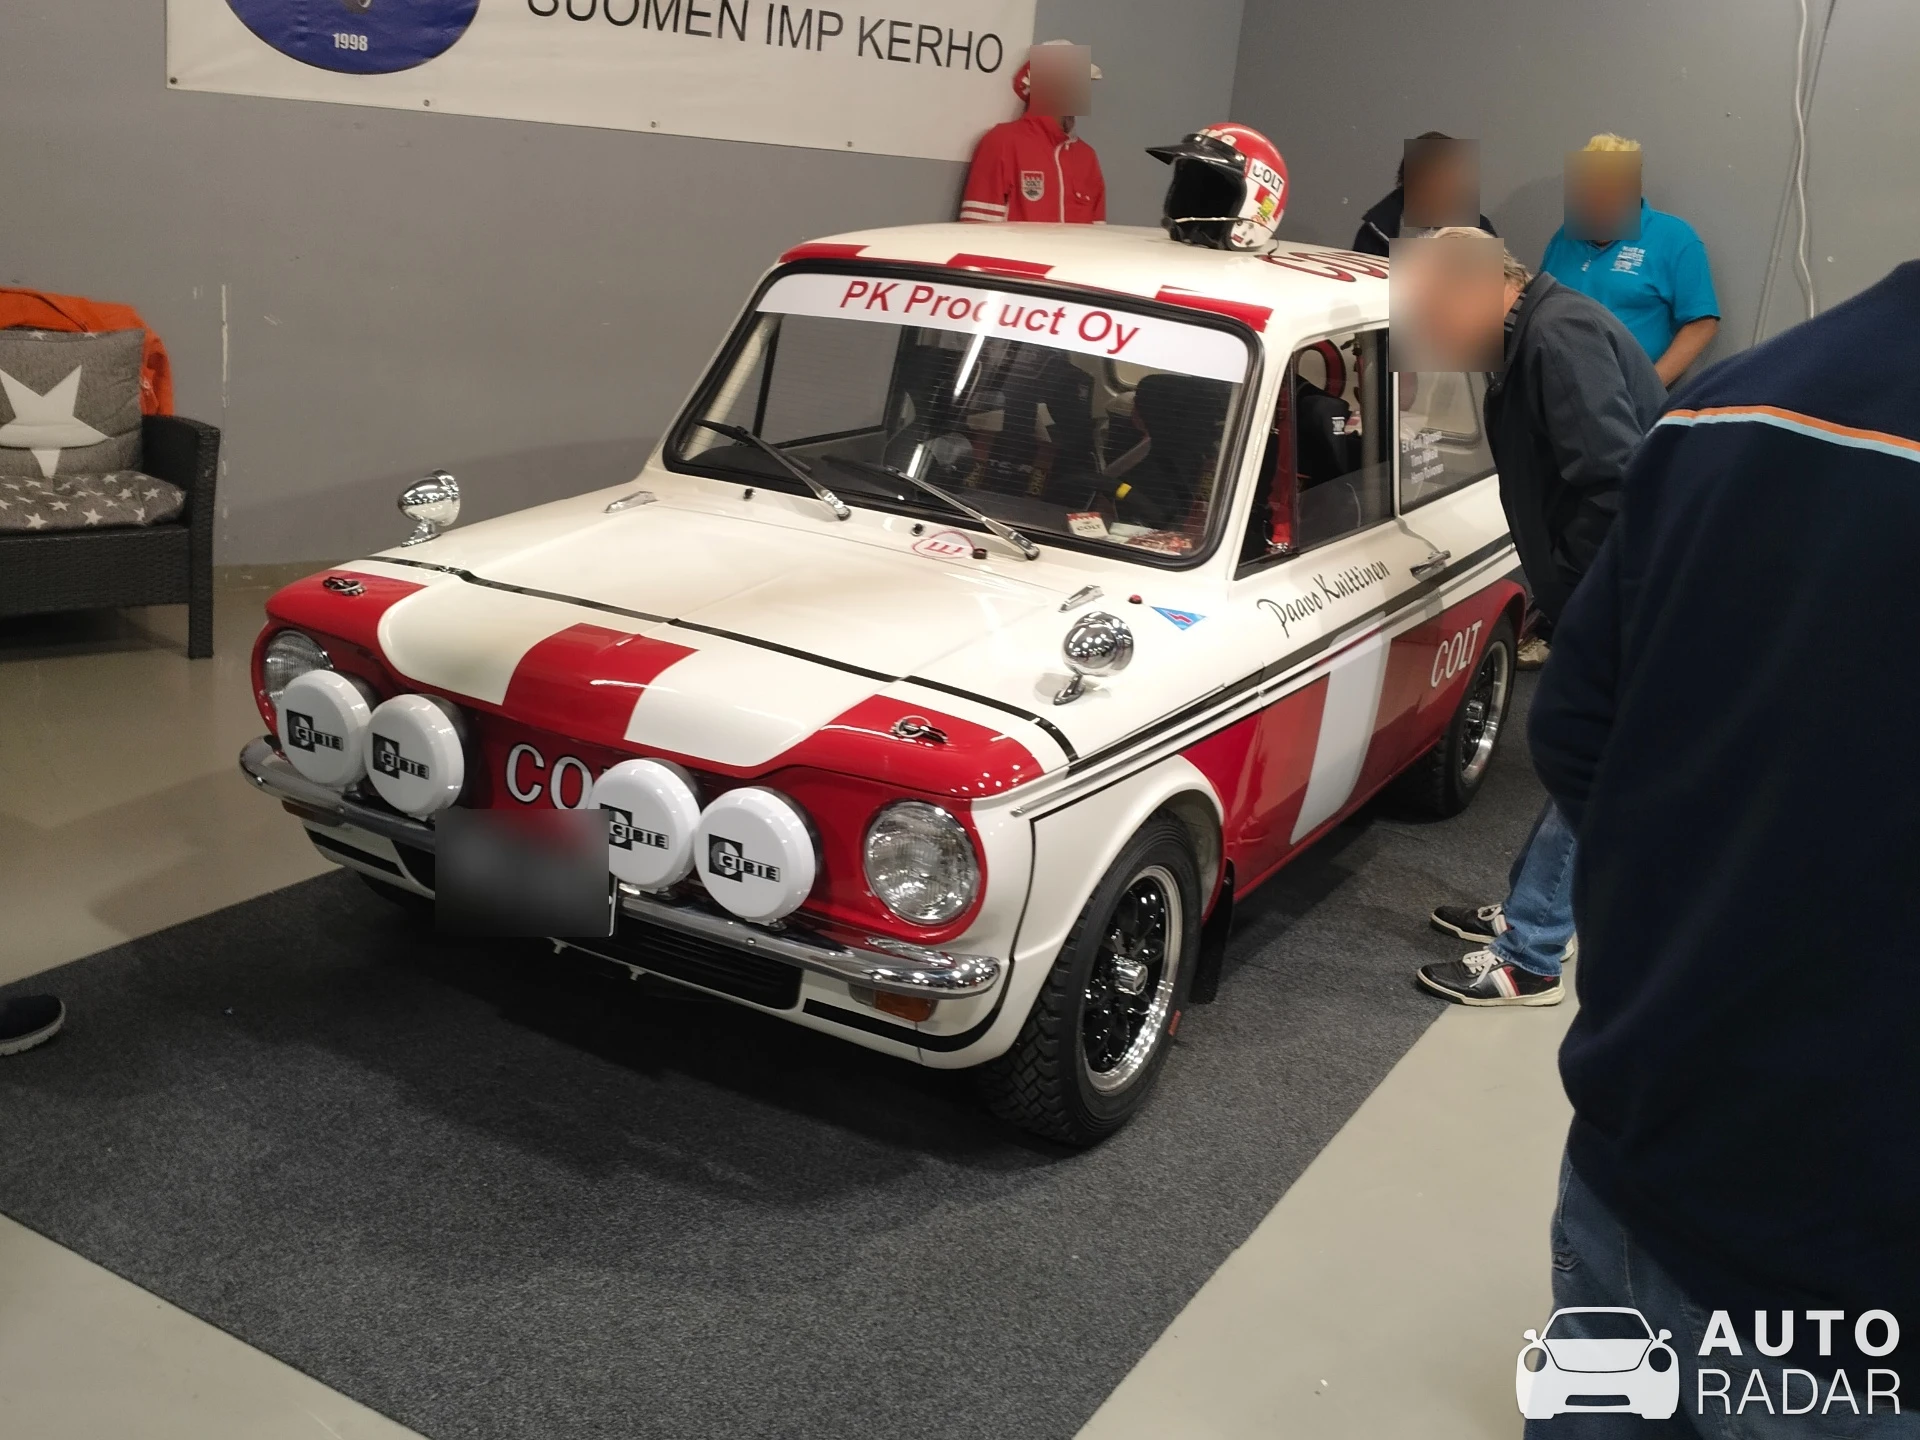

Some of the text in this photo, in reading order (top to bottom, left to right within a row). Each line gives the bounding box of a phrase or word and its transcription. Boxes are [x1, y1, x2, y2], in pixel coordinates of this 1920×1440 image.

[332, 32, 369, 52] 1998
[765, 3, 844, 52] IMP
[857, 15, 1004, 74] KERHO
[1252, 163, 1284, 194] COLT
[1253, 251, 1389, 283] CO
[839, 280, 901, 312] PK
[1078, 310, 1141, 355] Oy
[1256, 560, 1391, 639] Paavo Kuittinen
[1431, 619, 1483, 688] COLT
